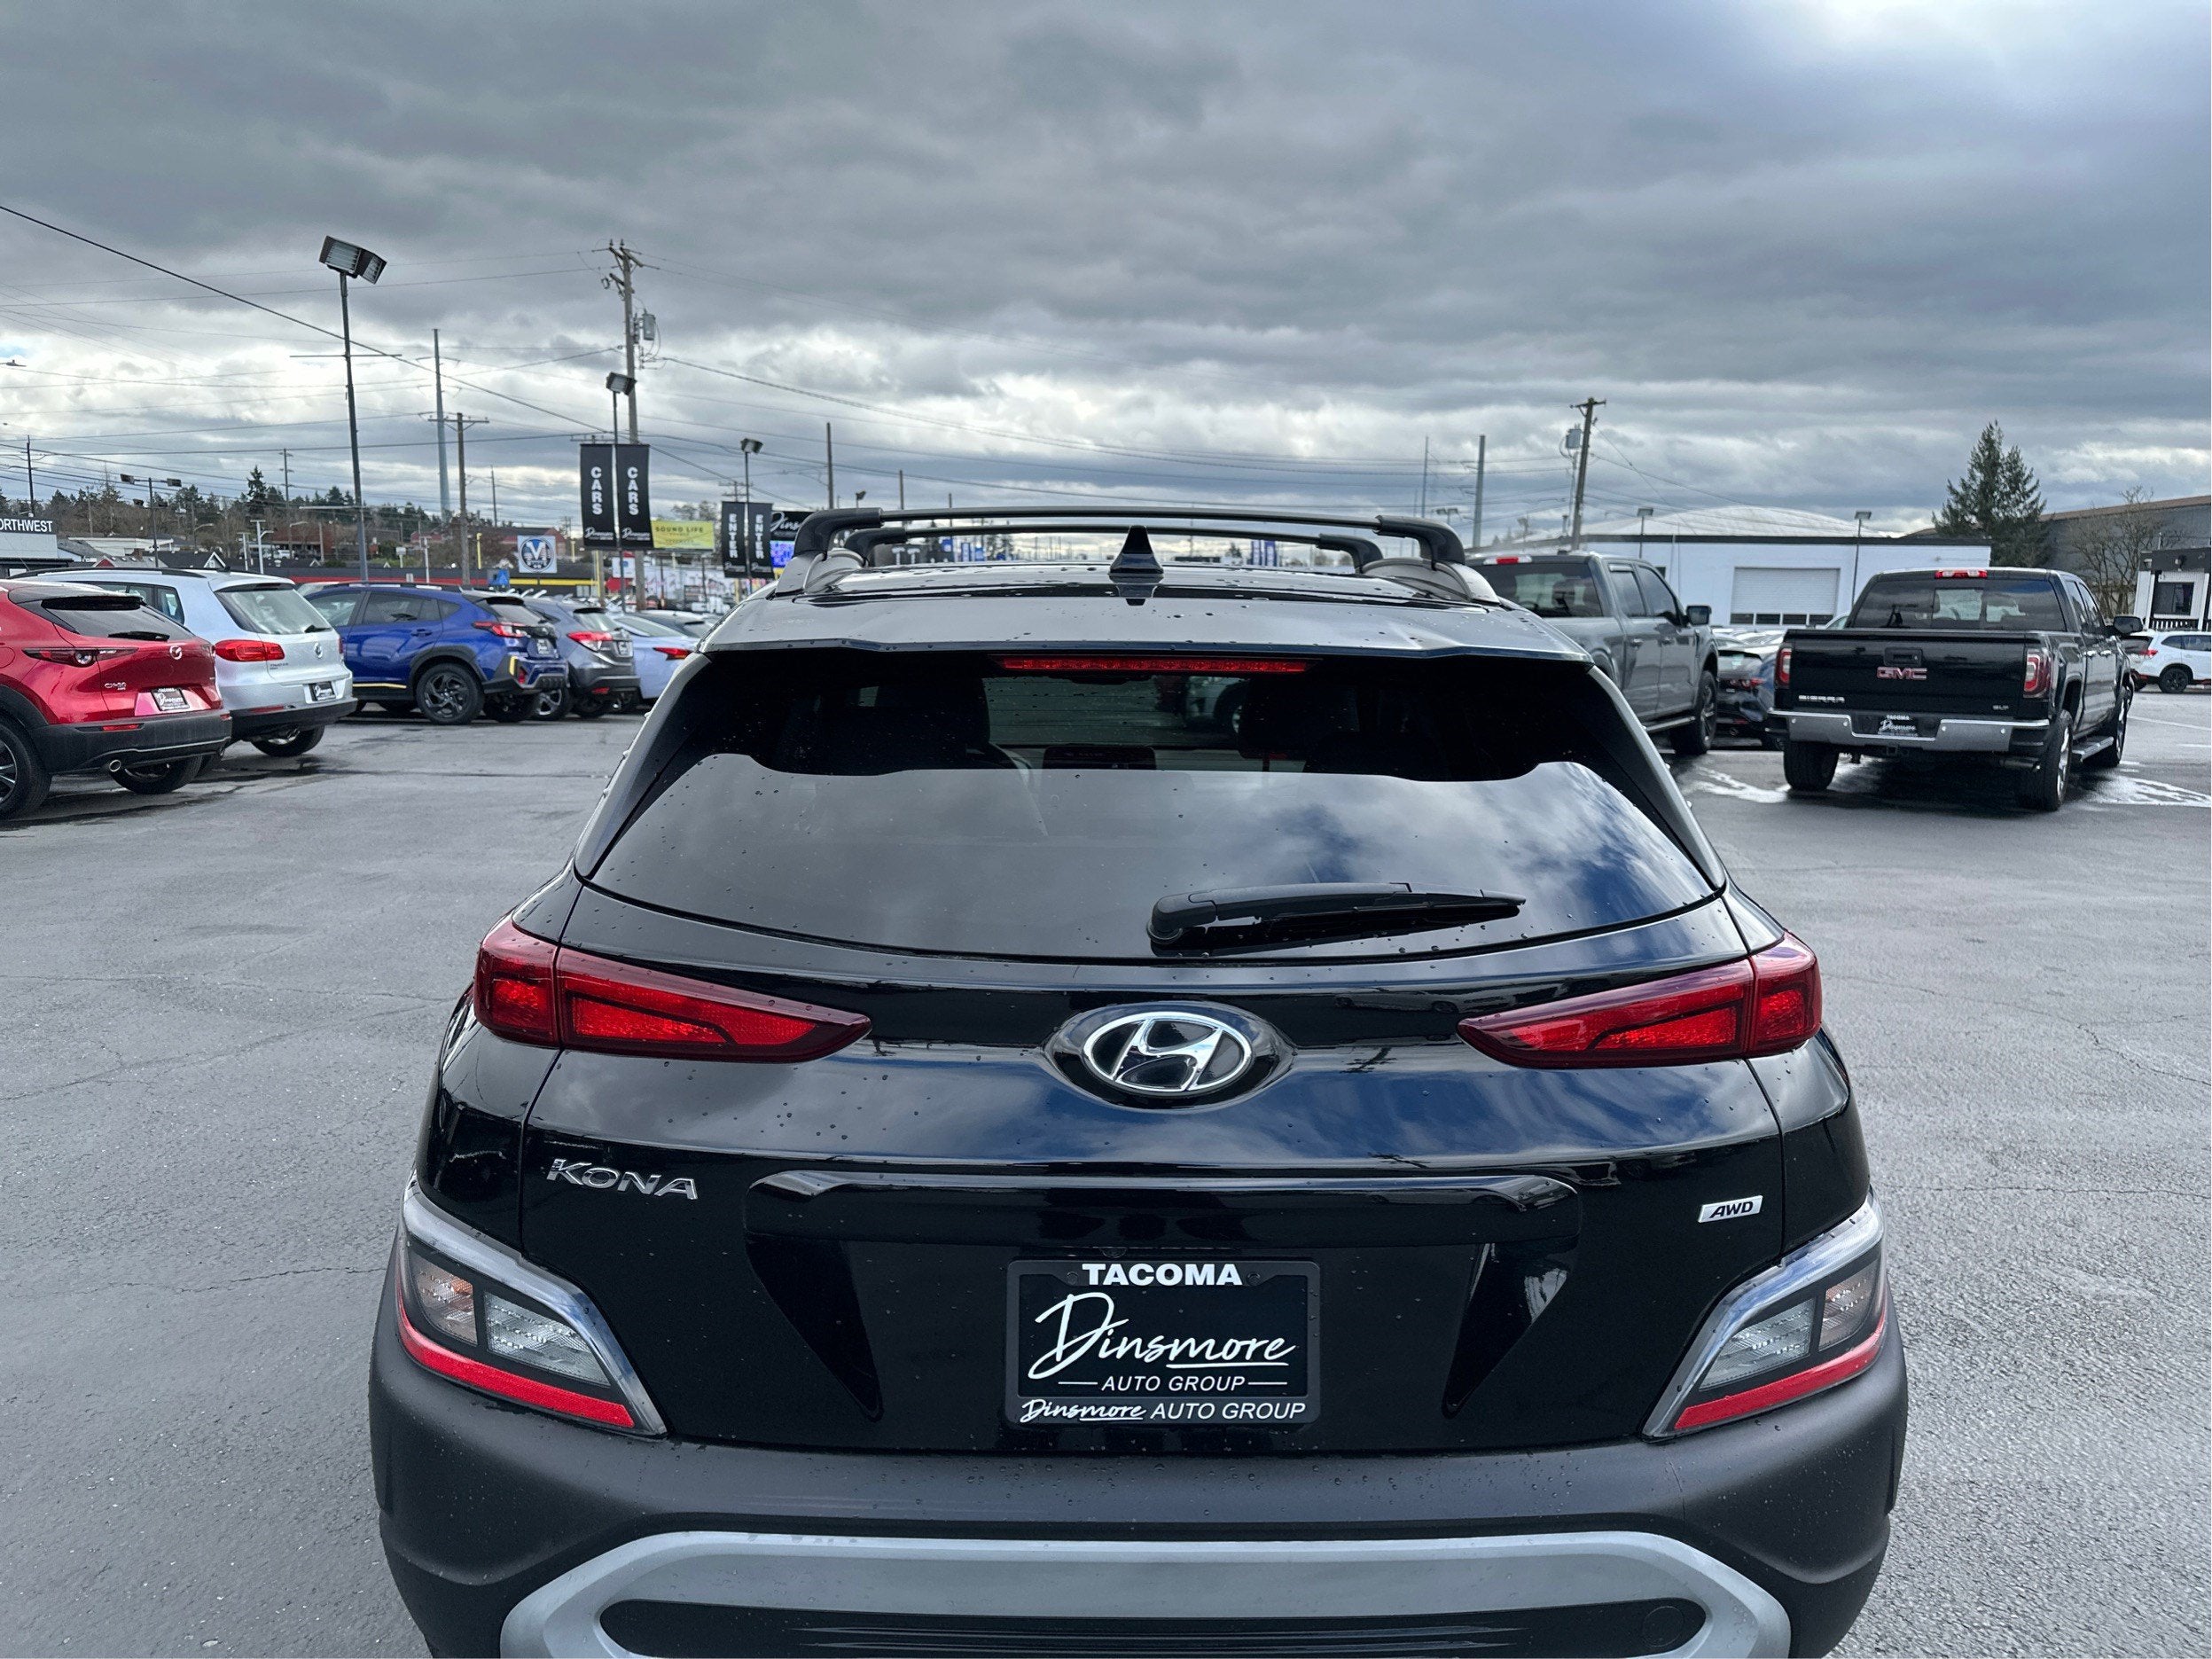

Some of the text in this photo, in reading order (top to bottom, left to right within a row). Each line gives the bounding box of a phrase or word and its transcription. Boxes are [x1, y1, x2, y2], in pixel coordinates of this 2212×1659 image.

[590, 466, 603, 515] CARS
[628, 466, 639, 515] CARS
[729, 513, 739, 558] ENTER
[755, 514, 764, 559] ENTER
[1877, 666, 1927, 680] GMC
[546, 1158, 699, 1200] KONA
[1708, 1201, 1754, 1219] AWD
[1082, 1263, 1243, 1287] TACOMA
[1028, 1292, 1297, 1380] Dinsmore
[1101, 1375, 1246, 1392] AUTO GROUP
[1020, 1398, 1306, 1423] Dinsmore AUTO GROUP
